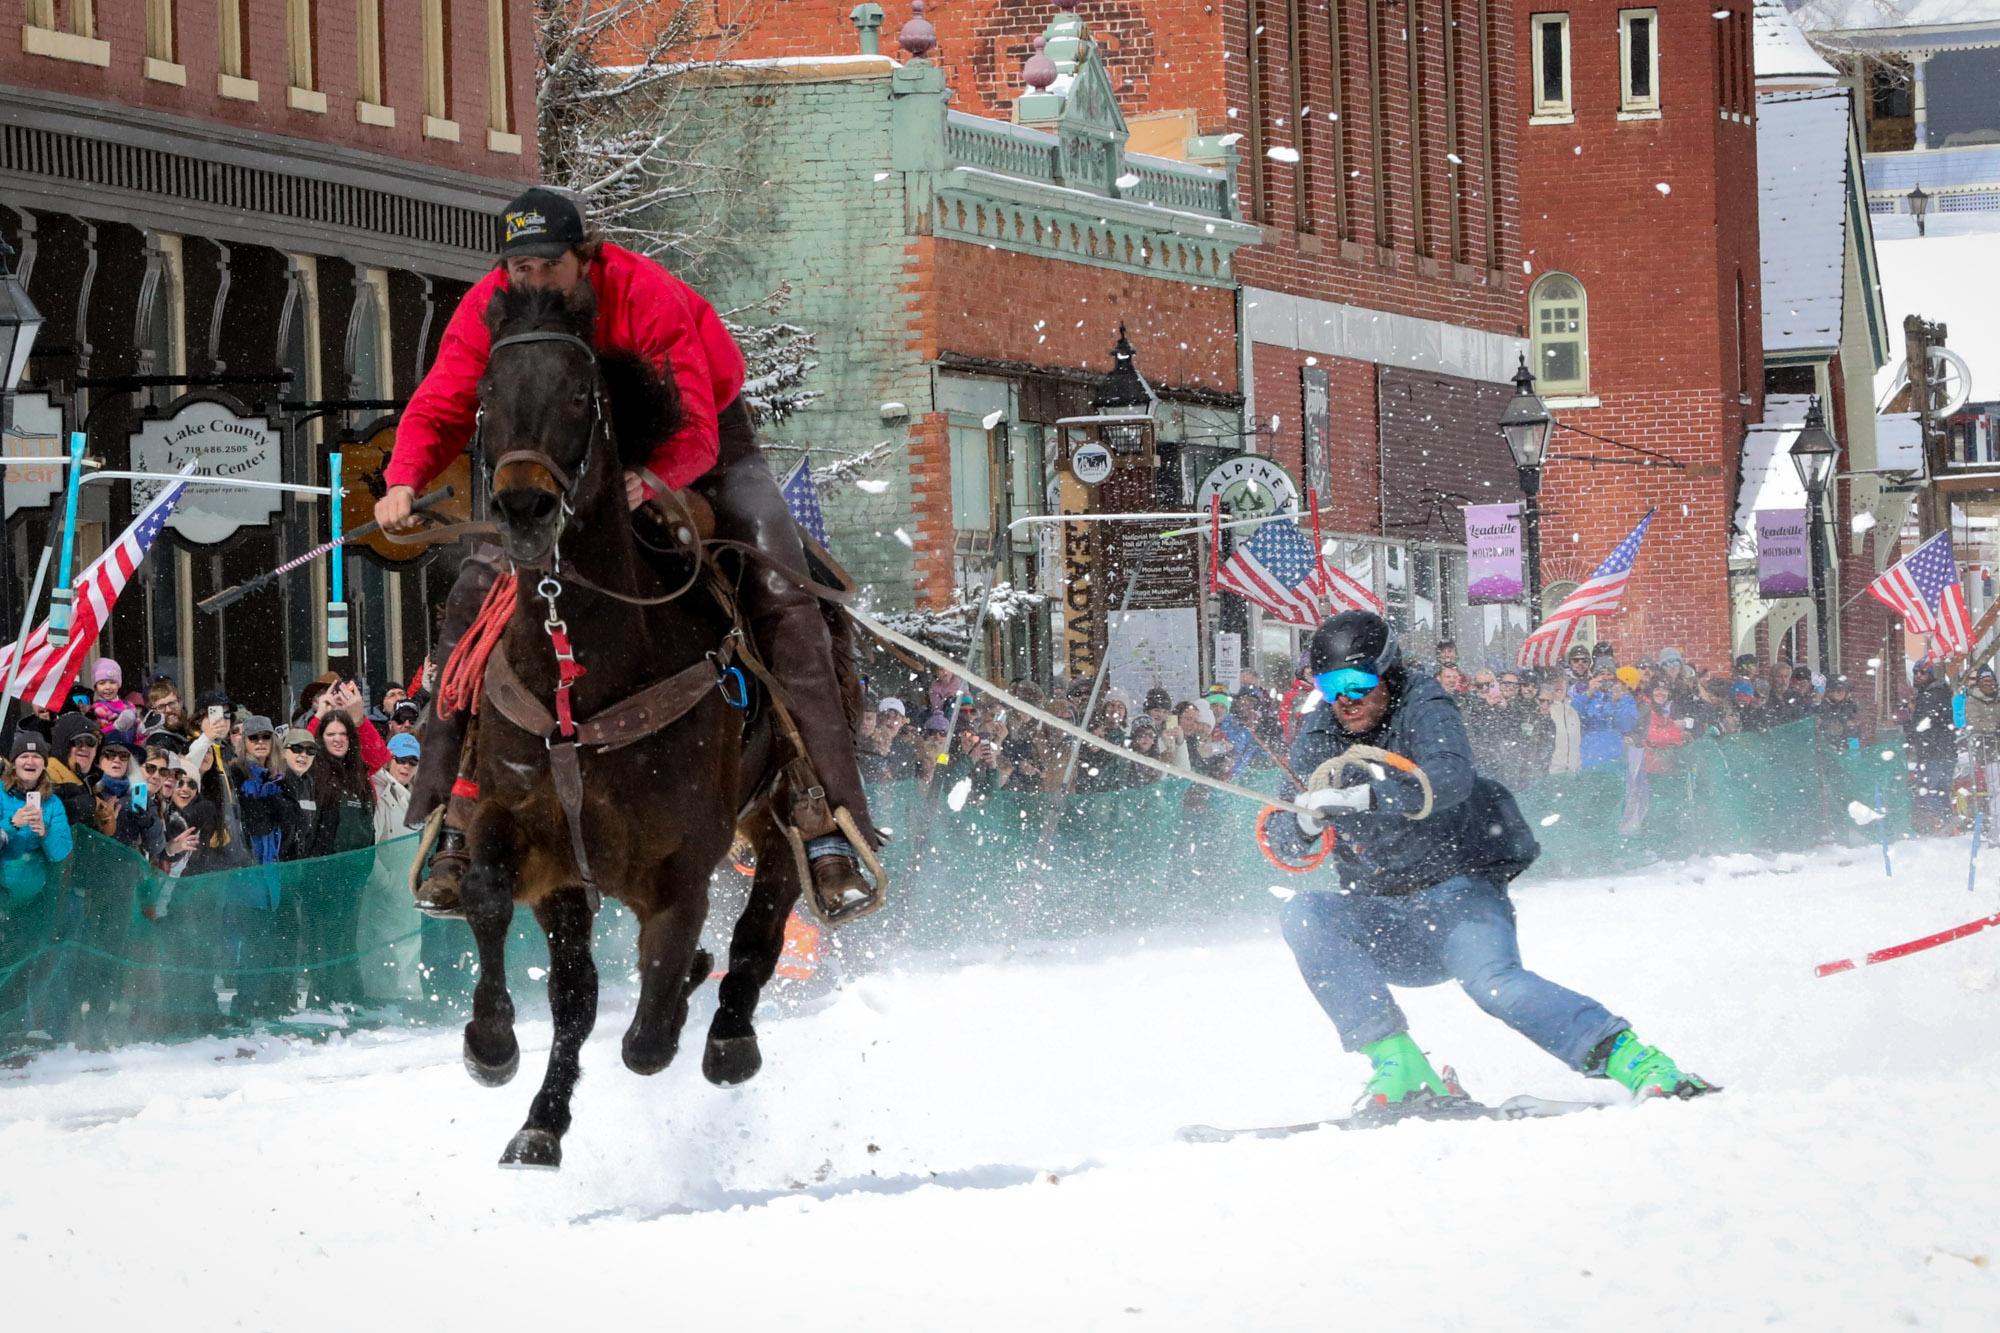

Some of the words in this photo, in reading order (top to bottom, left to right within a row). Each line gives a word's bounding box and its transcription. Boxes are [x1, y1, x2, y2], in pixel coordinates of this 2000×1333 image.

[163, 424, 206, 446] Lake
[210, 419, 270, 446] County
[215, 450, 266, 476] Center
[1122, 533, 1148, 541] National
[1469, 522, 1518, 539] Leadville
[1759, 525, 1803, 539] Leadville
[1161, 539, 1188, 547] Museum
[1163, 565, 1190, 573] Museum
